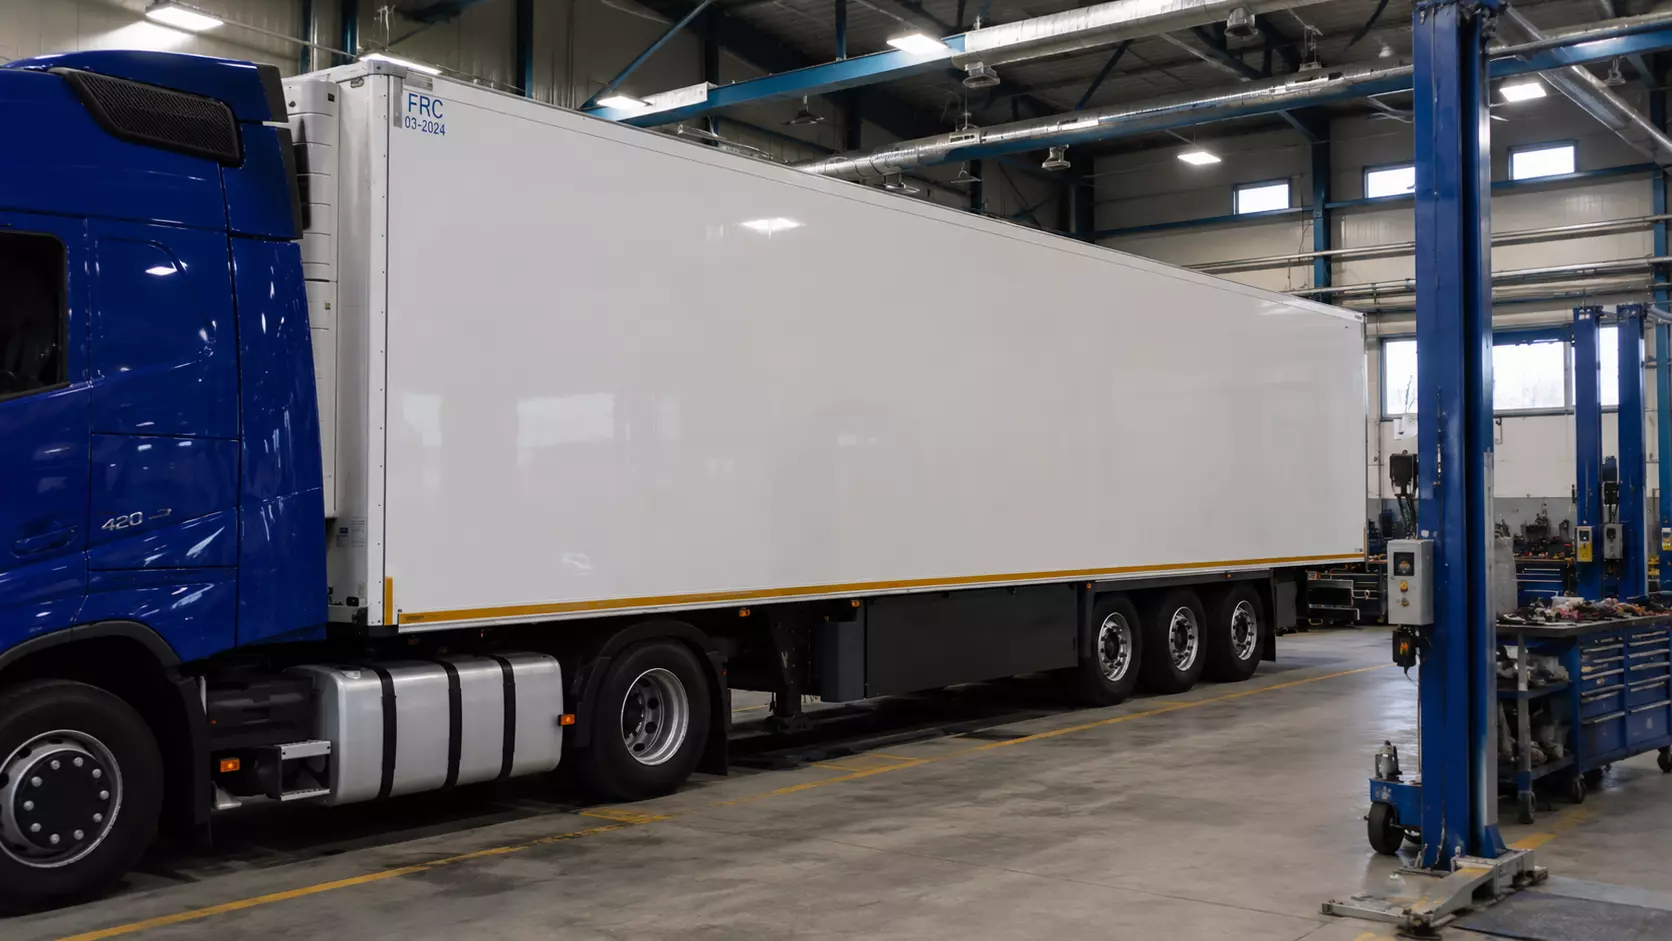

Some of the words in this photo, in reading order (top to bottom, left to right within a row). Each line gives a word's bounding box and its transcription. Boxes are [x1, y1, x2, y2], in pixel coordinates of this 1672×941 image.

[408, 92, 443, 119] FRC
[404, 115, 446, 136] 03-2024
[101, 511, 143, 531] 420
